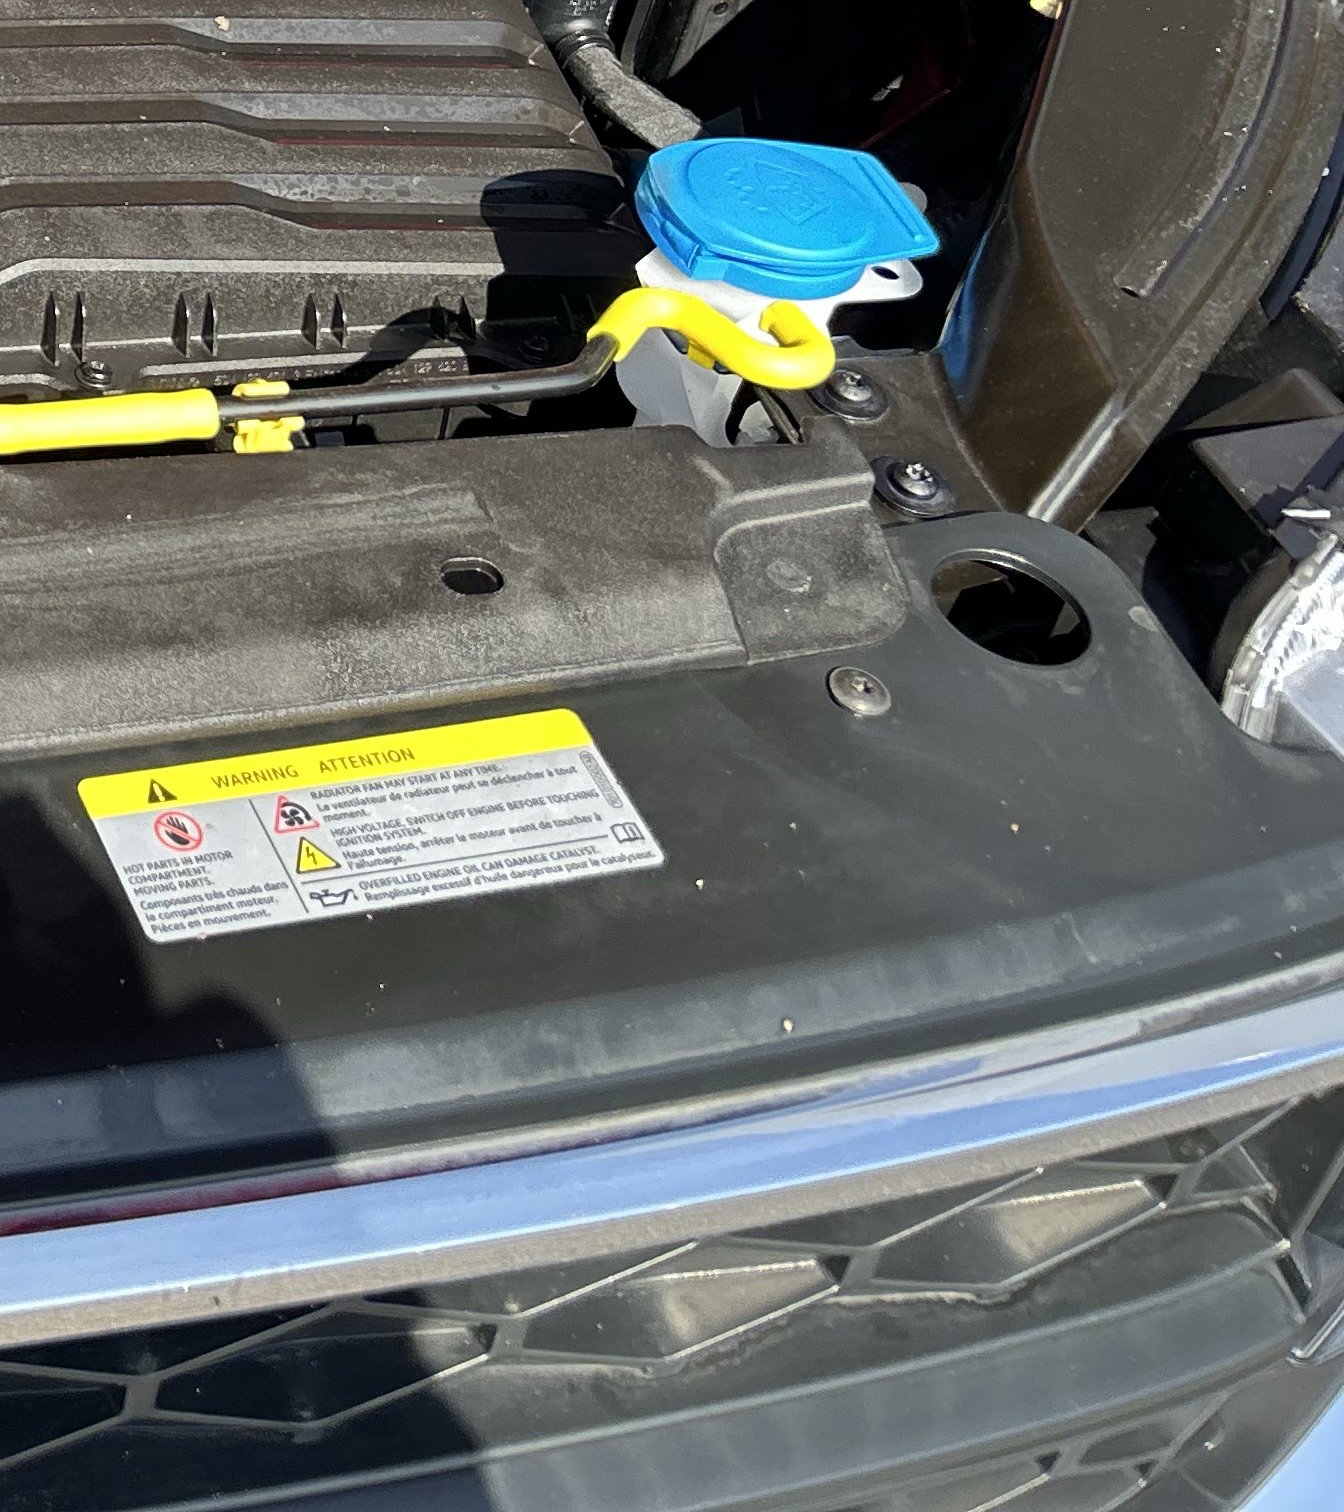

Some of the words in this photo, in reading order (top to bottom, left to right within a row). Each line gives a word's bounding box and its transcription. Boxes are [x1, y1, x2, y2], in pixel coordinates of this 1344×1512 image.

[211, 765, 299, 788] WARNING
[316, 748, 415, 772] ATTENTION
[310, 785, 361, 799] RADIATOR
[362, 782, 383, 791] FAN
[384, 778, 406, 788] MAY
[407, 773, 437, 784] START
[438, 771, 451, 780] AT
[451, 768, 473, 778] ANY
[474, 764, 502, 774] TIME.
[316, 802, 330, 811] Le
[331, 794, 387, 809] ventilateur
[388, 792, 402, 800] de
[403, 784, 450, 798] radiateur
[451, 781, 476, 792] peut
[490, 770, 545, 785] déclencher
[555, 765, 577, 775] tout
[330, 826, 357, 838] HIGH
[406, 812, 445, 826] SWITCH
[446, 809, 467, 819] OFF
[467, 803, 505, 816] ENGINE
[506, 797, 546, 810] BEFORE
[546, 788, 599, 803] TOUCHING
[335, 833, 382, 847] IGNITION
[342, 848, 375, 860] Haute
[420, 835, 455, 848] arrêter
[455, 833, 467, 842] le
[467, 827, 506, 840] moteur
[507, 824, 537, 834] avant
[537, 819, 552, 829] de
[552, 813, 593, 826] toucher
[593, 811, 601, 819] à
[123, 864, 145, 874] HOT
[147, 858, 179, 870] PARTS
[181, 856, 192, 865] IN
[194, 850, 232, 863] MOTOR
[358, 873, 422, 891] OVERFILLED
[422, 866, 461, 881] ENGINE
[462, 863, 480, 874] OIL
[480, 859, 503, 871] CAN
[503, 852, 548, 867] DAMAGE
[133, 882, 176, 896] MOVING
[178, 876, 213, 888] PARTS.
[140, 892, 203, 910] Composants
[225, 883, 261, 896] chauds
[262, 878, 287, 890] dans
[365, 885, 431, 904] Remplissage
[431, 878, 472, 892] excessif
[509, 863, 563, 879] dangereux
[563, 858, 588, 870] pour
[588, 856, 600, 866] le
[146, 913, 156, 922] le
[158, 900, 233, 920] compartiment
[151, 920, 186, 934] Pièces
[188, 920, 201, 928] en
